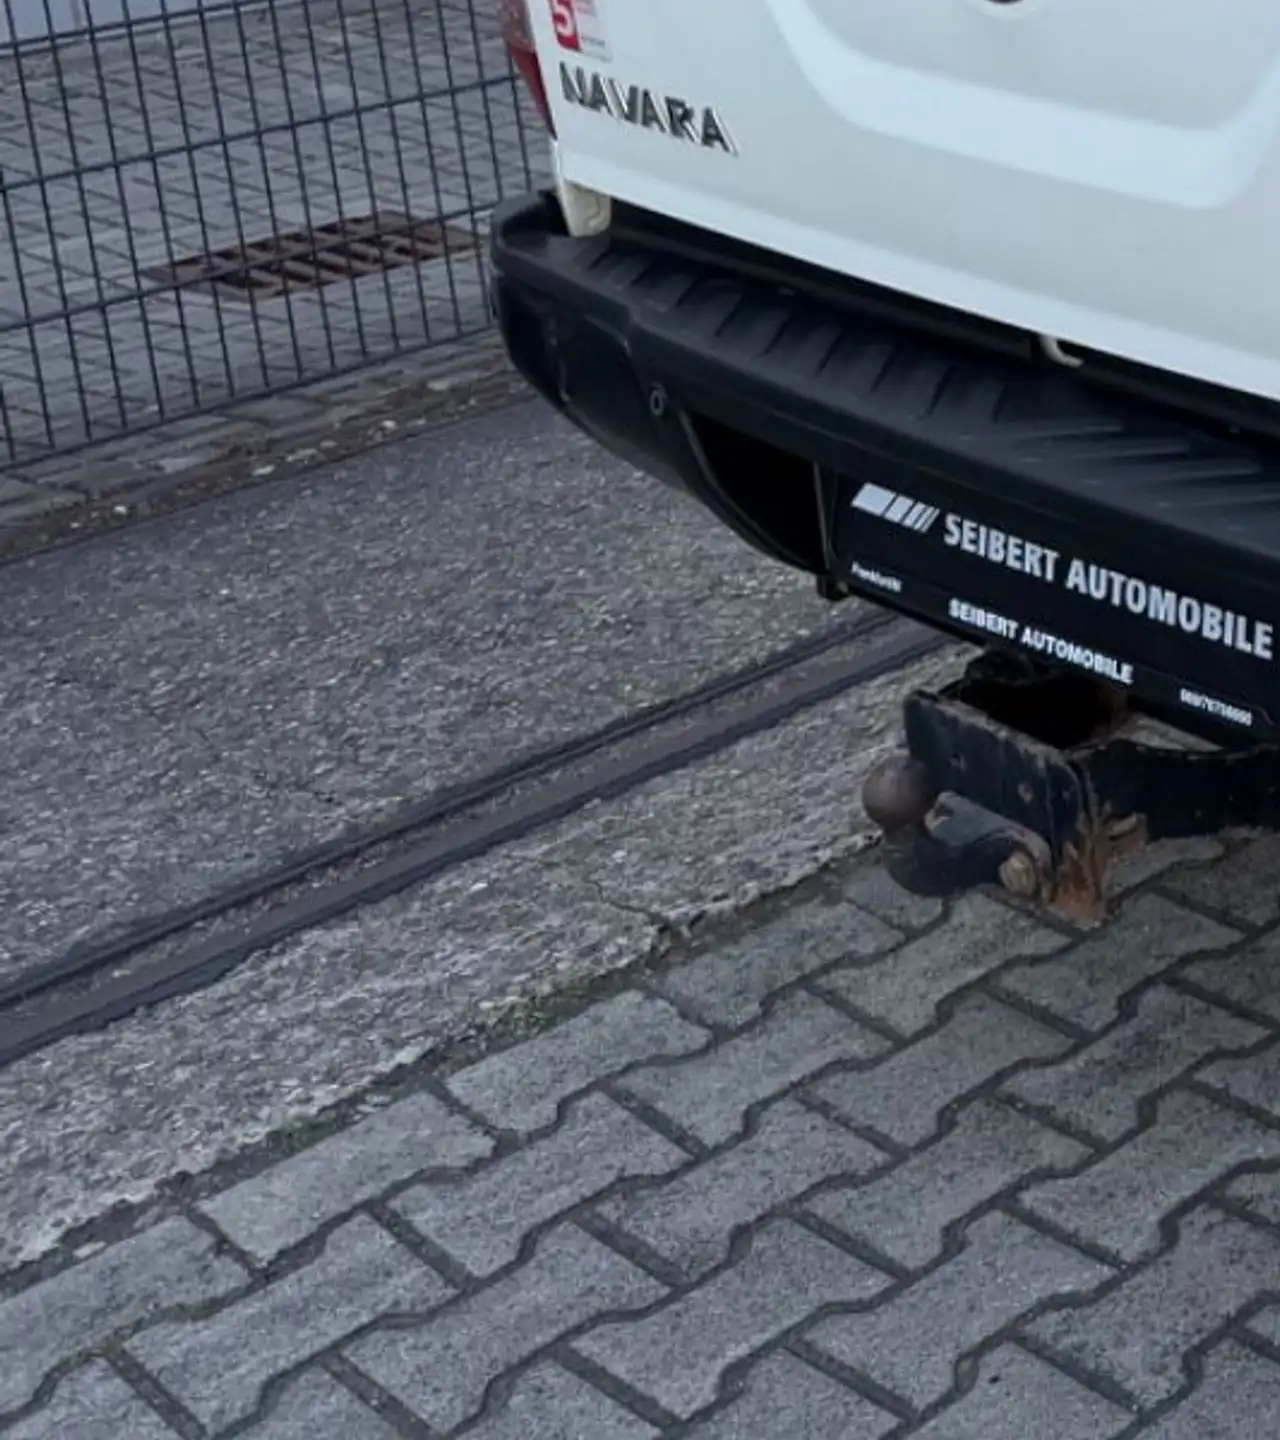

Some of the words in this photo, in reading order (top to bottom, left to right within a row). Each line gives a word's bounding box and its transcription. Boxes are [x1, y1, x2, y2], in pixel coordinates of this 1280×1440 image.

[560, 62, 739, 157] NAVARA
[943, 513, 1060, 582] SEIBERT
[1065, 558, 1274, 660] AUTOMOBILE
[949, 598, 1020, 640] SEIBERT
[1021, 626, 1134, 685] AUTOMOBILE
